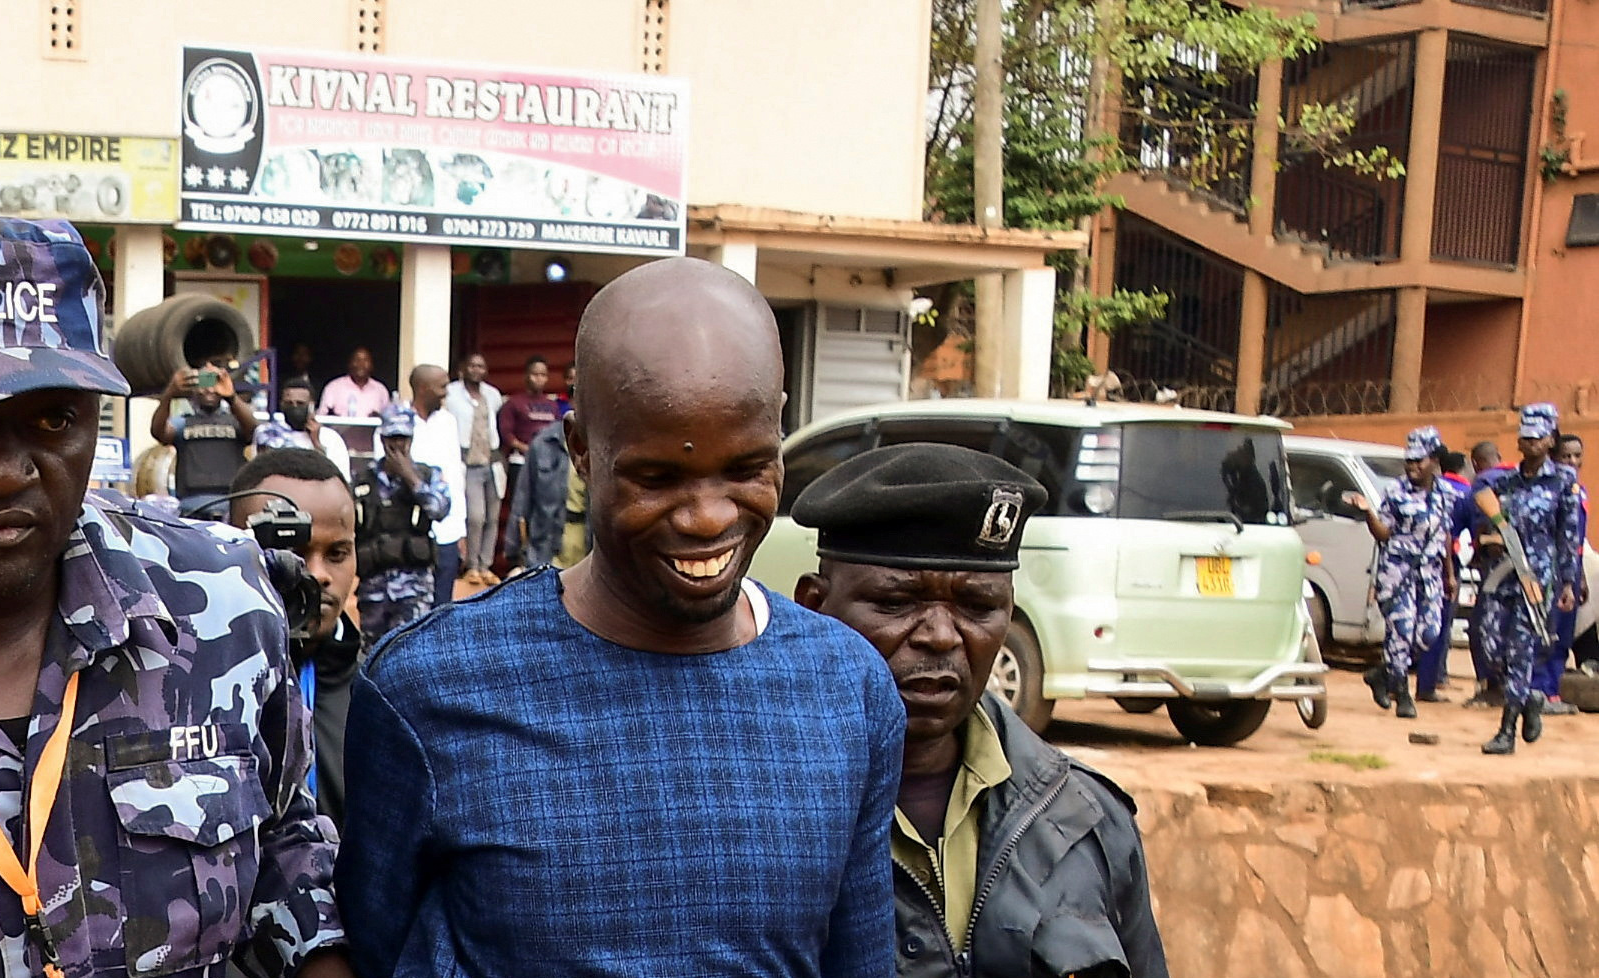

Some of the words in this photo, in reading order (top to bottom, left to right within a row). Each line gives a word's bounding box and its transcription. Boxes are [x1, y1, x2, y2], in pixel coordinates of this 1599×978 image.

[268, 63, 418, 117] KIVNAL
[425, 75, 677, 135] RESTAURANT
[27, 135, 121, 161] EMPIRE
[190, 202, 222, 221] TEL:
[333, 211, 368, 229] 0772
[616, 228, 669, 247] KAVULE
[183, 423, 236, 440] PRESS
[169, 724, 218, 760] FFU
